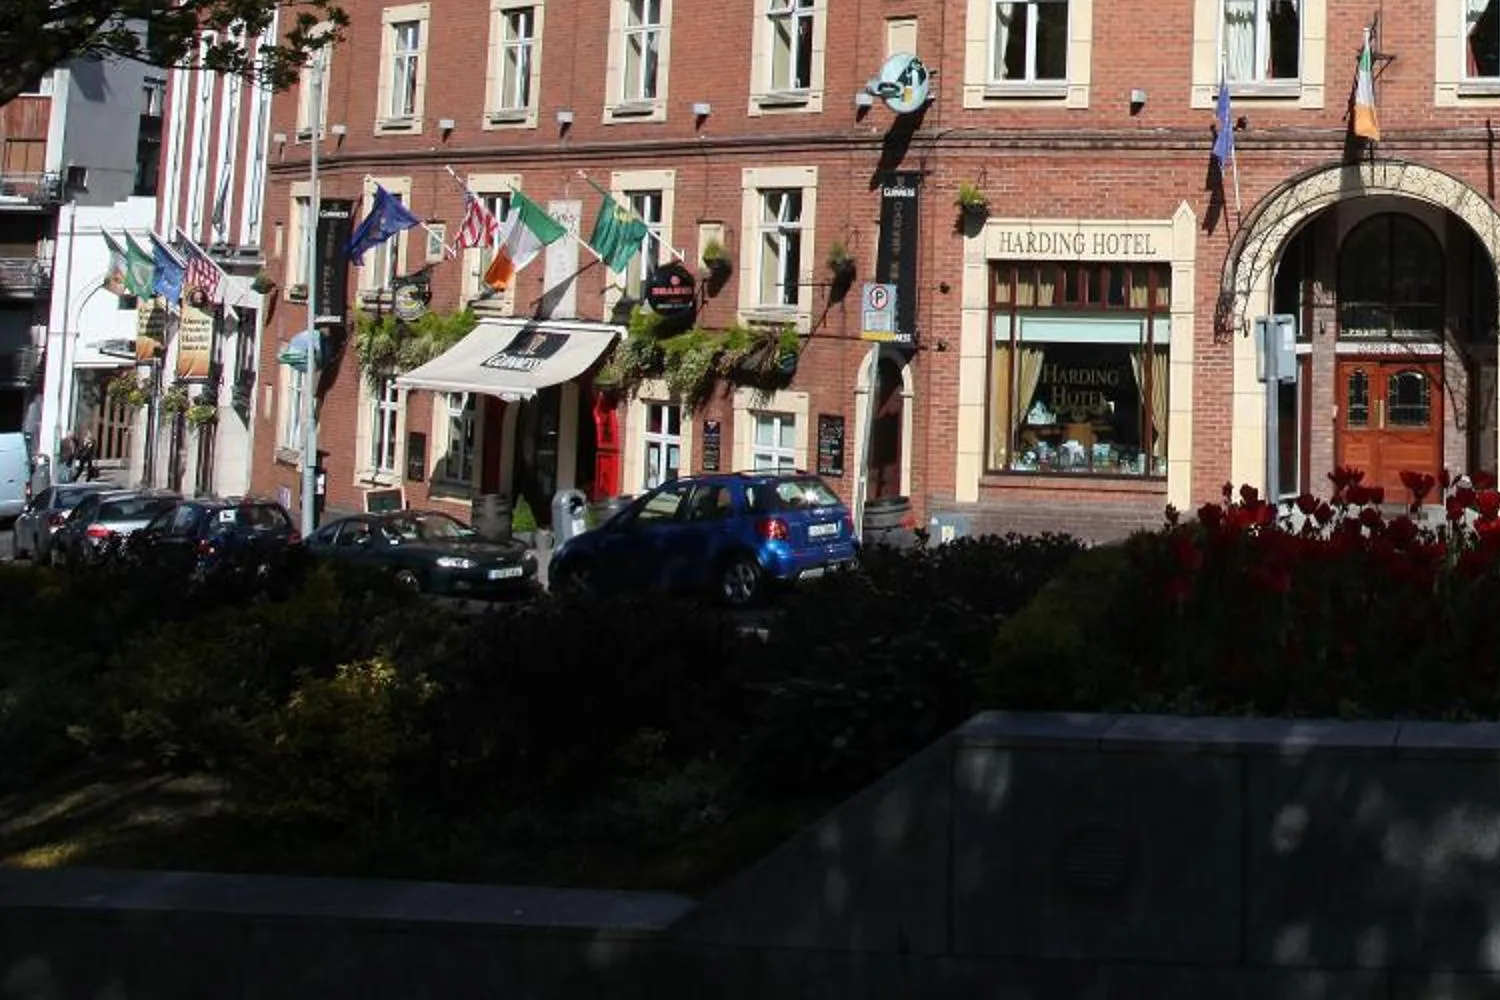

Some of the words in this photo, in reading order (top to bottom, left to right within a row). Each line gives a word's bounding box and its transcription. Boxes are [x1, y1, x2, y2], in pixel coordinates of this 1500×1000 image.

[999, 232, 1085, 254] HARDING
[1092, 233, 1157, 255] HOTEL
[1042, 364, 1119, 386] HARDING
[1052, 384, 1107, 406] HOTEL
